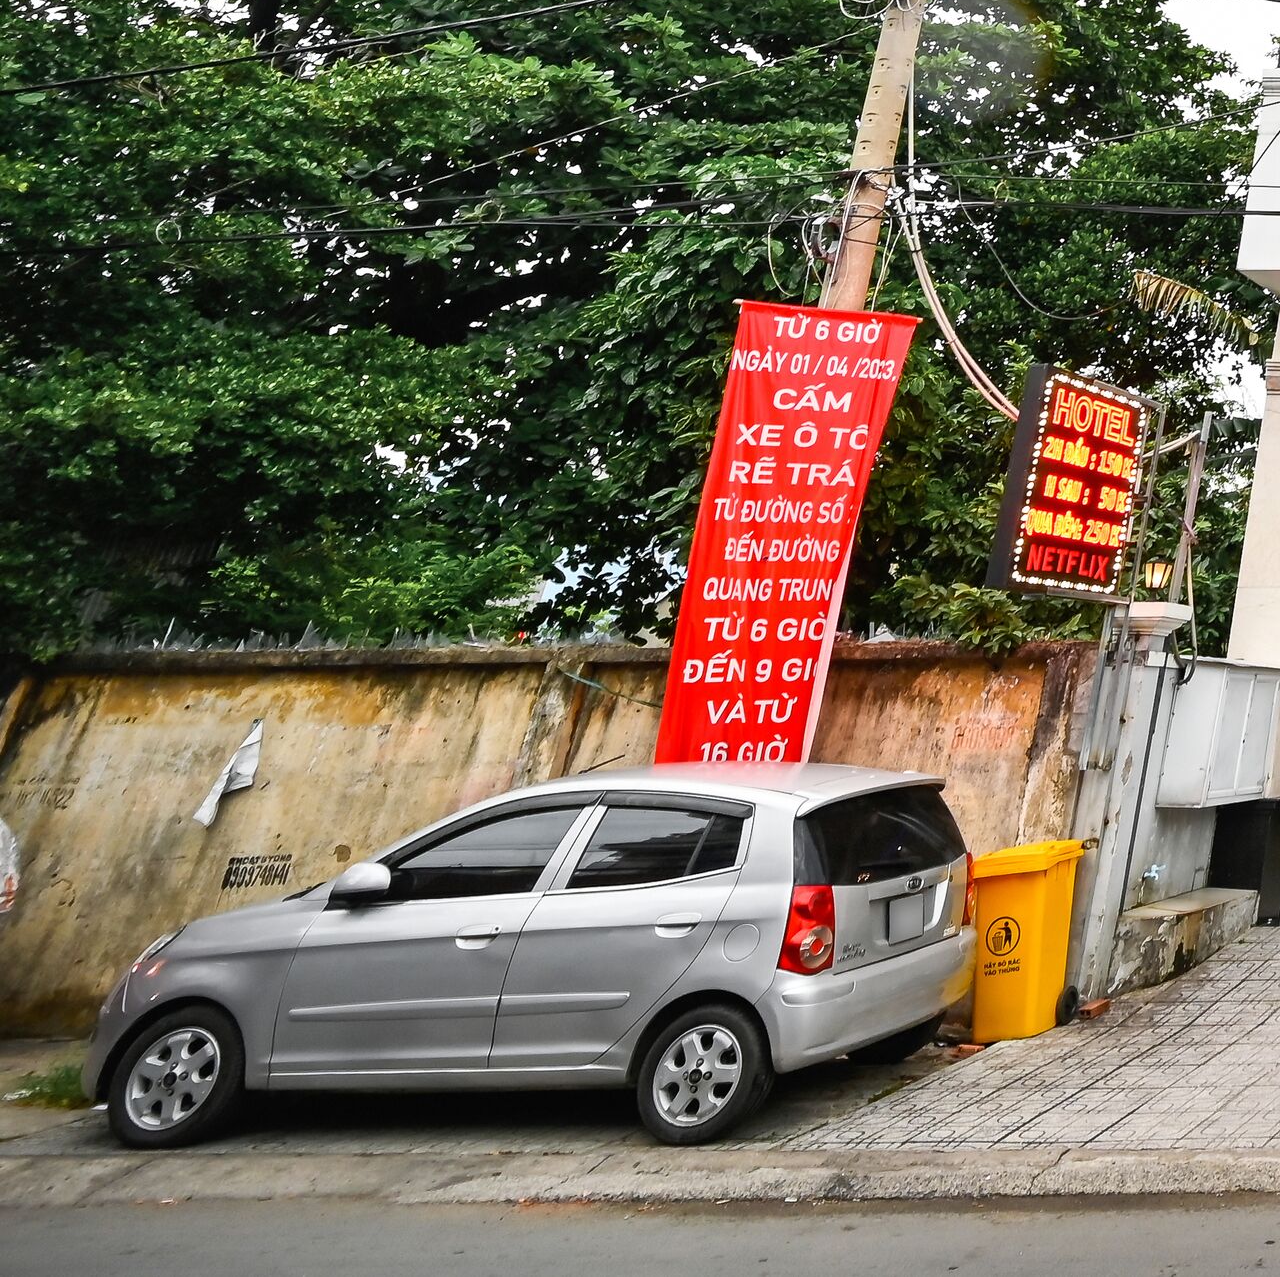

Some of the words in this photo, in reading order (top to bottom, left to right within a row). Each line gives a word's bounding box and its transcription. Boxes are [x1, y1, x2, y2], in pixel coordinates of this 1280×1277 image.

[773, 313, 810, 339] TỪ
[815, 320, 830, 340] 6
[837, 319, 882, 344] GIỜ
[731, 346, 789, 373] NGÀY
[790, 353, 809, 373] 01
[827, 355, 849, 377] 04
[773, 383, 852, 412] CẤM
[1053, 388, 1134, 447] HOTEL
[736, 423, 784, 447] XE
[793, 421, 818, 448] Ô
[829, 423, 869, 450] TÔ
[1043, 436, 1063, 461] 2H
[728, 456, 777, 484] RẼ
[786, 459, 856, 487] TRÁ
[1057, 478, 1083, 505] SAU
[740, 494, 813, 523] ĐƯỜNG
[816, 493, 848, 523] SỐ
[724, 530, 763, 562] ĐẾN
[768, 533, 840, 563] ĐƯỜNG
[1026, 543, 1110, 581] NETFLIX
[703, 577, 772, 601] QUANG
[778, 578, 835, 601] TRUN
[704, 611, 744, 641] TỪ
[750, 618, 767, 641] 6
[683, 649, 745, 683] ĐẾN
[755, 659, 772, 683] 9
[707, 693, 746, 724] VÀ
[754, 692, 797, 724] TỪ
[700, 741, 728, 763] 16
[737, 734, 789, 763] GIỜ
